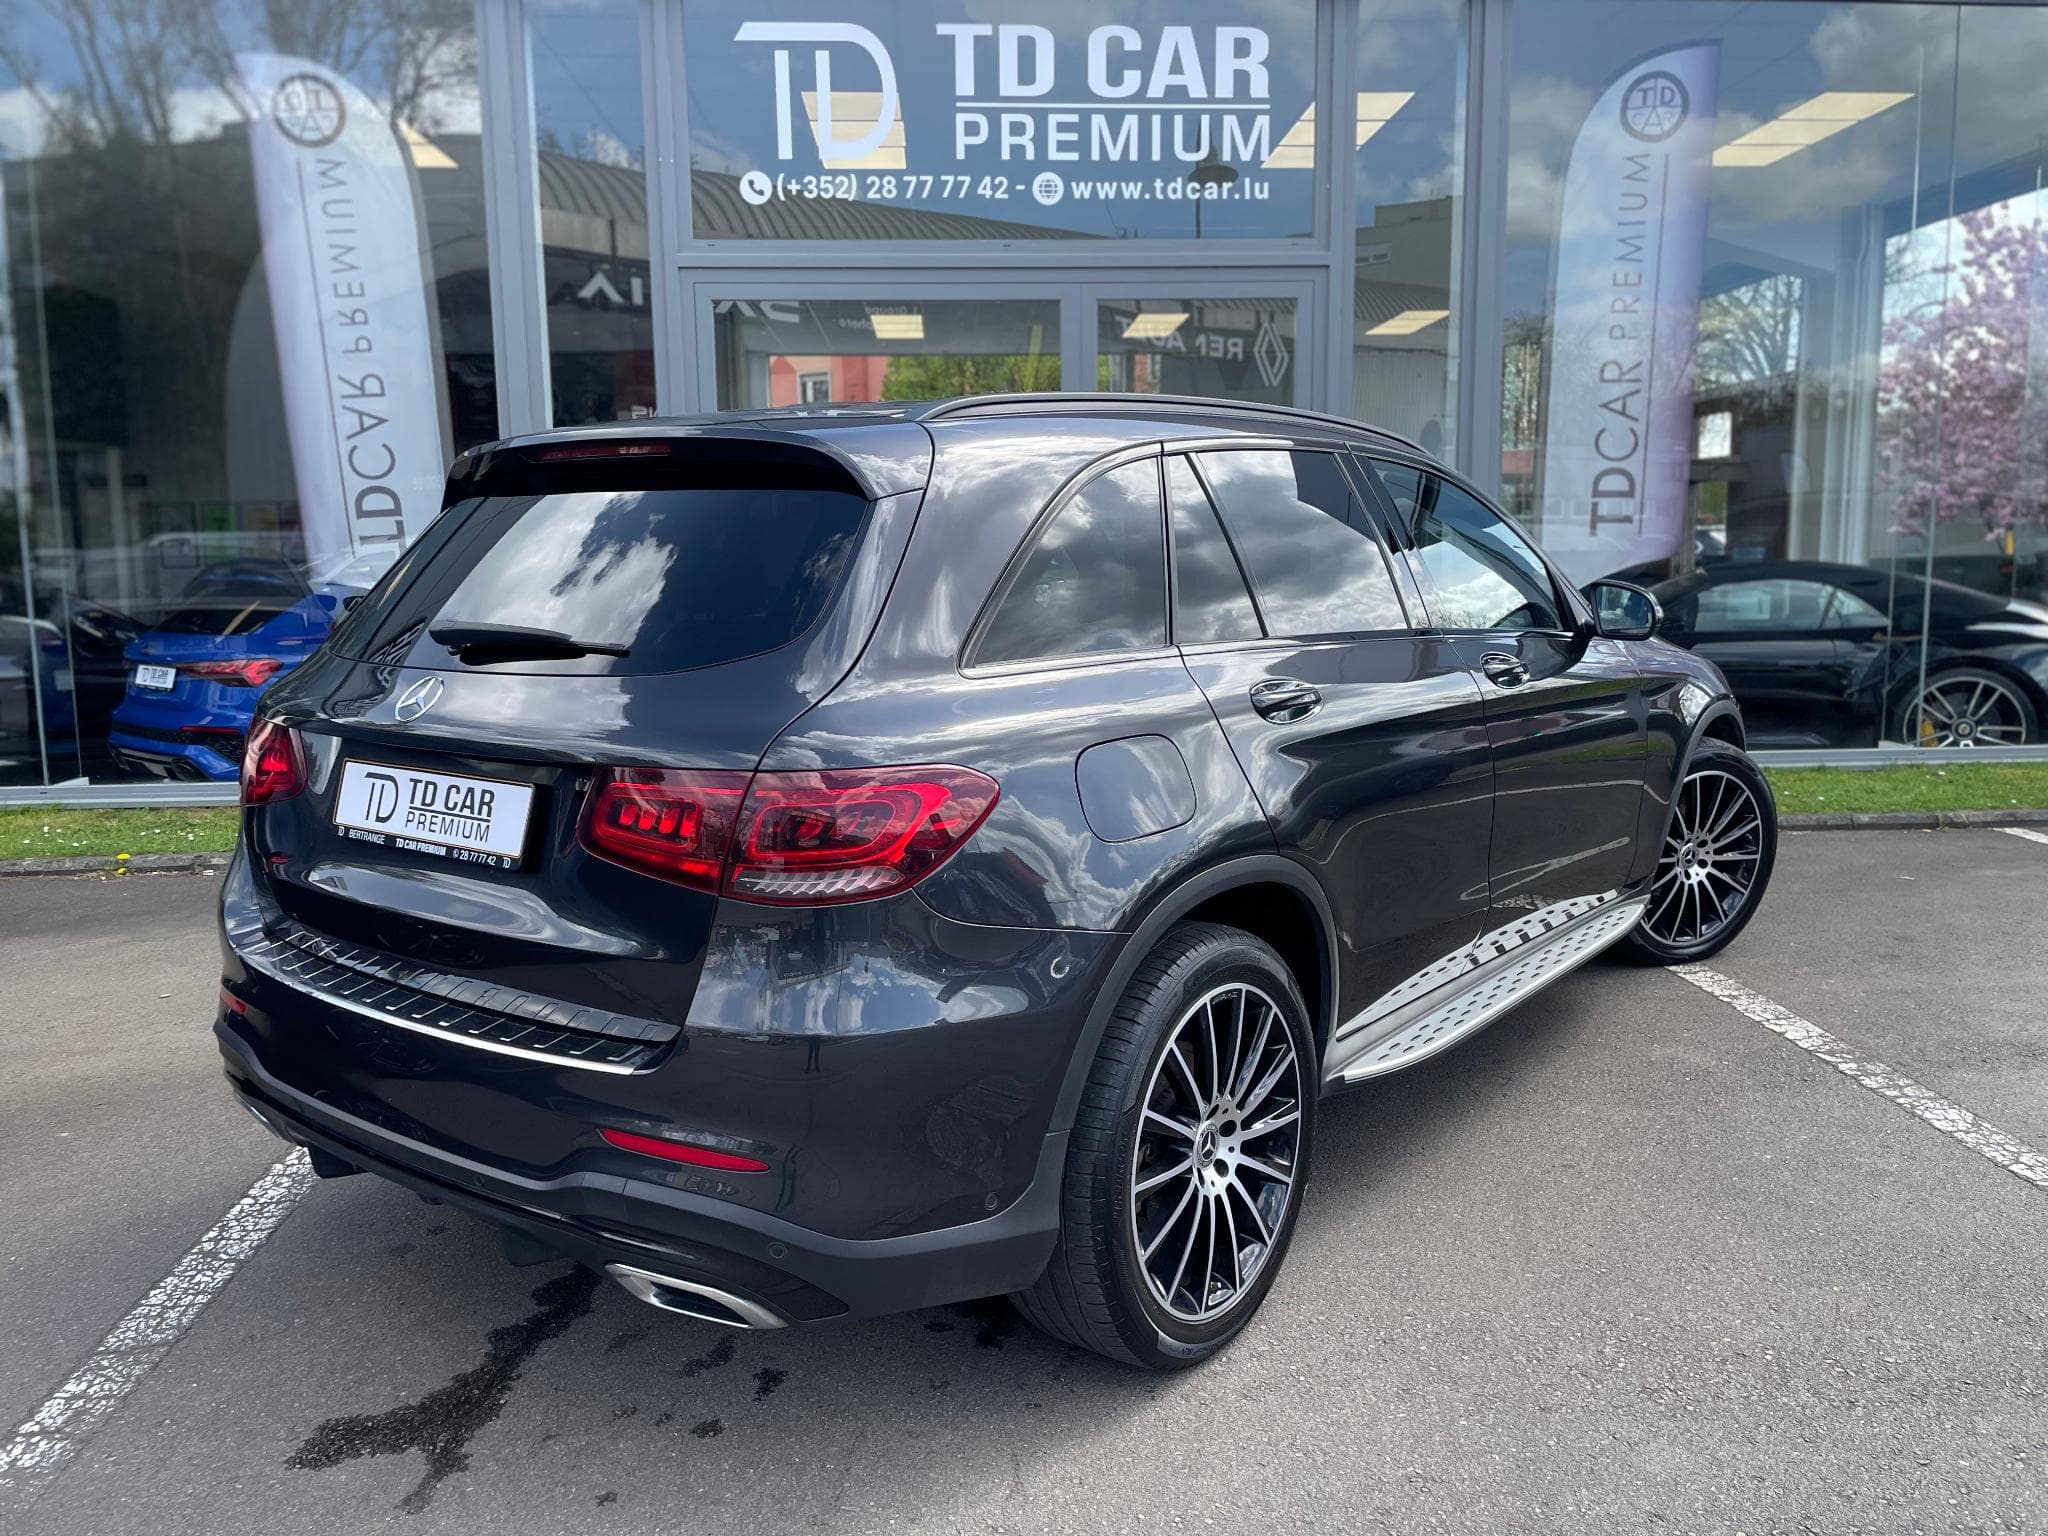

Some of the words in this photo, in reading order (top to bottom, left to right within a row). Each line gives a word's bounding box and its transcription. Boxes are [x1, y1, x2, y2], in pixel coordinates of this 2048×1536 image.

[936, 23, 1055, 97] TD
[1087, 25, 1271, 98] CAR
[955, 113, 1271, 162] PREMIUM
[777, 173, 857, 201] (+352)
[866, 175, 897, 199] 28
[903, 175, 933, 199] 77
[941, 175, 971, 199] 77
[977, 175, 1009, 199] 42
[1071, 177, 1269, 200] www.tdcar.lu
[1609, 153, 1651, 341] PREMIUM
[1590, 361, 1643, 536] TDCAR
[409, 778, 438, 807] TD
[444, 784, 496, 818] CAR
[348, 829, 386, 844] BERTRANGE
[417, 842, 447, 857] PREMIUM
[460, 850, 469, 861] 28
[487, 855, 497, 866] 42
[405, 810, 491, 843] PREMIUM
